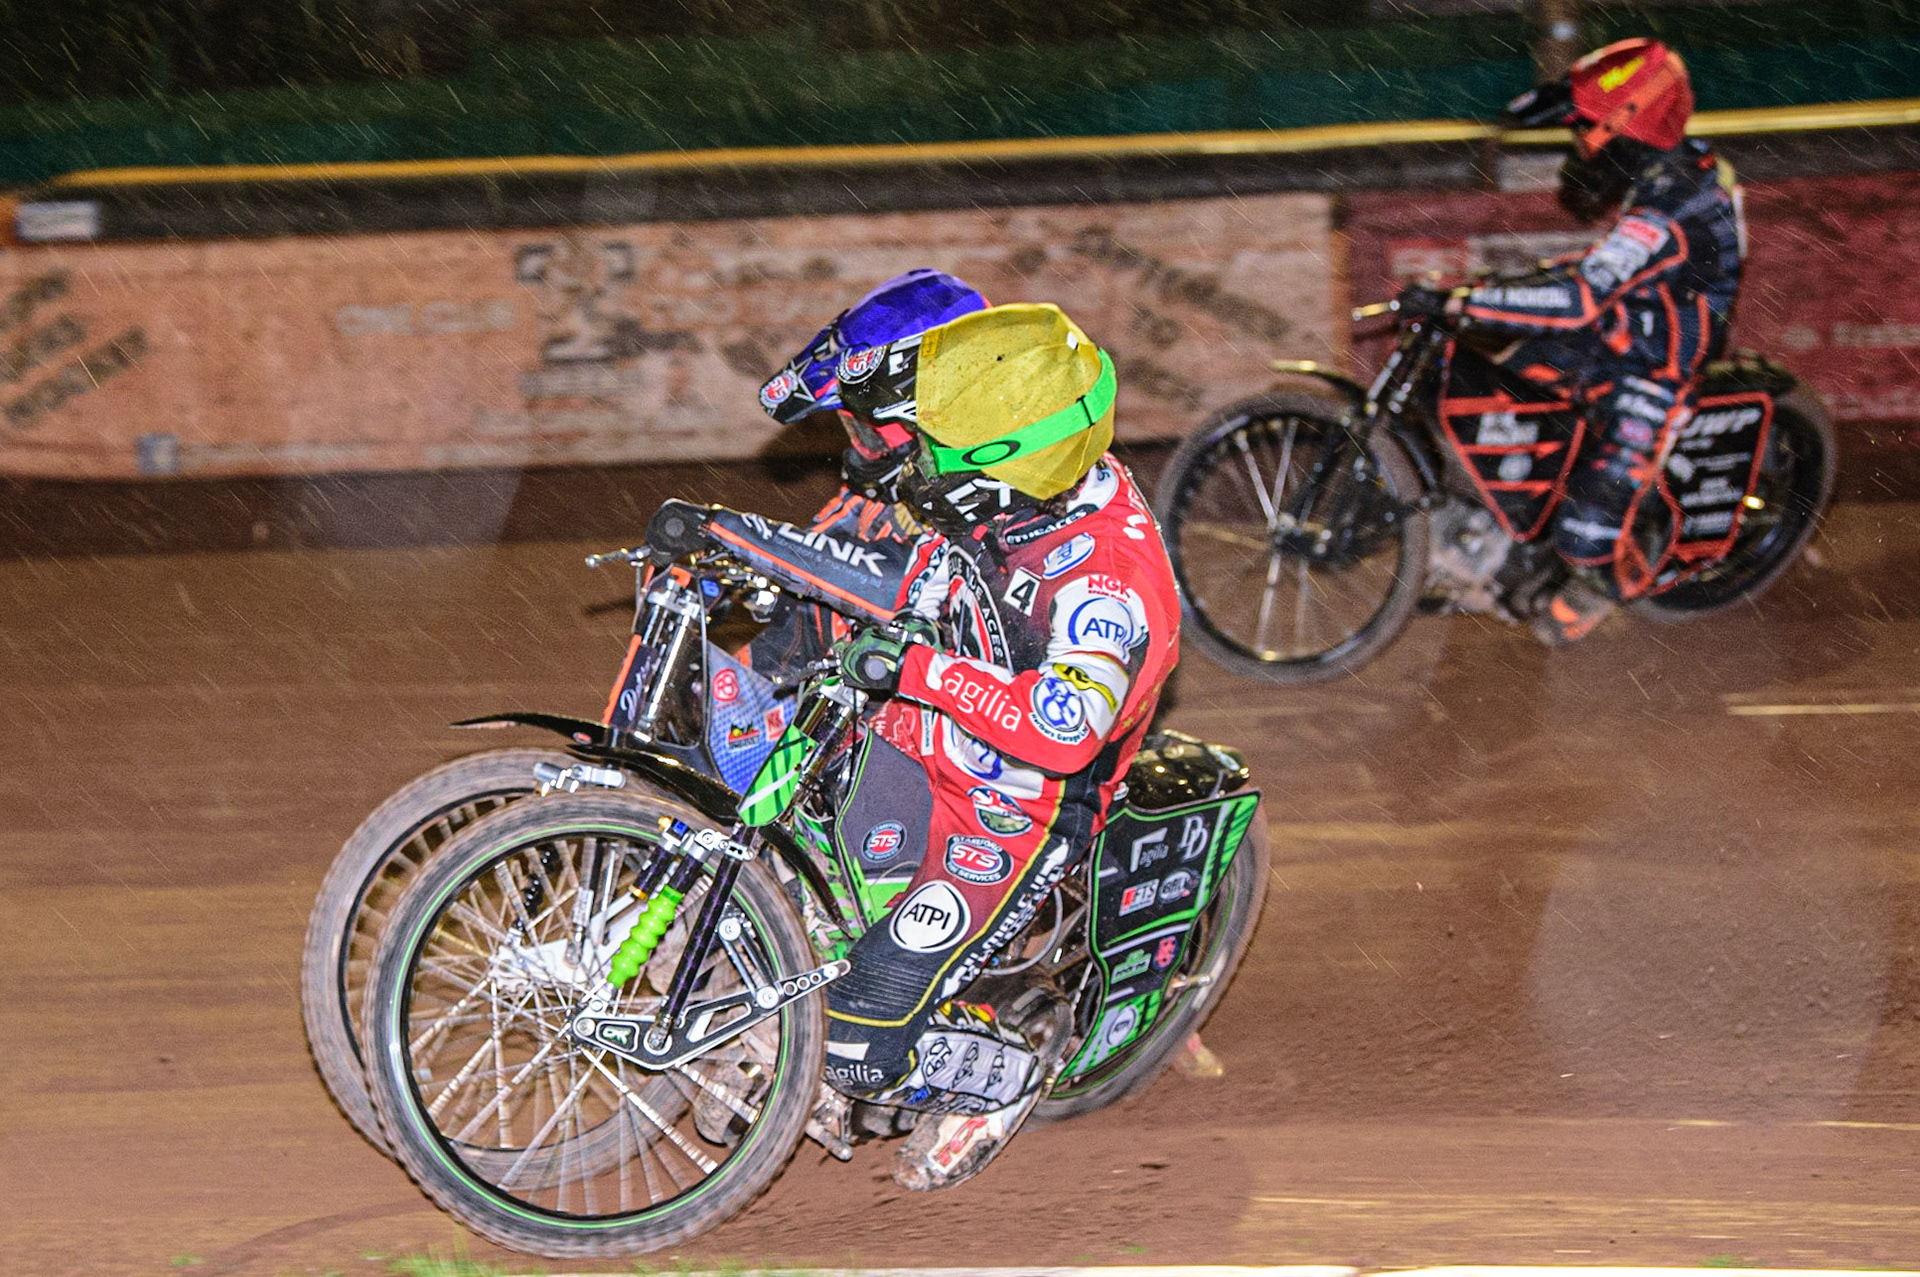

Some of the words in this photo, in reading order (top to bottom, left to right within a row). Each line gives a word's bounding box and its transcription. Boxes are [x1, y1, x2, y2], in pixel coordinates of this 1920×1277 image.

[777, 522, 888, 577] LINK
[1011, 578, 1036, 610] 4
[1088, 575, 1131, 599] NGK
[943, 668, 1023, 733] agilia
[869, 834, 899, 848] STS
[951, 844, 999, 869] STS
[903, 903, 952, 931] ATPI
[825, 1065, 885, 1086] agilia
